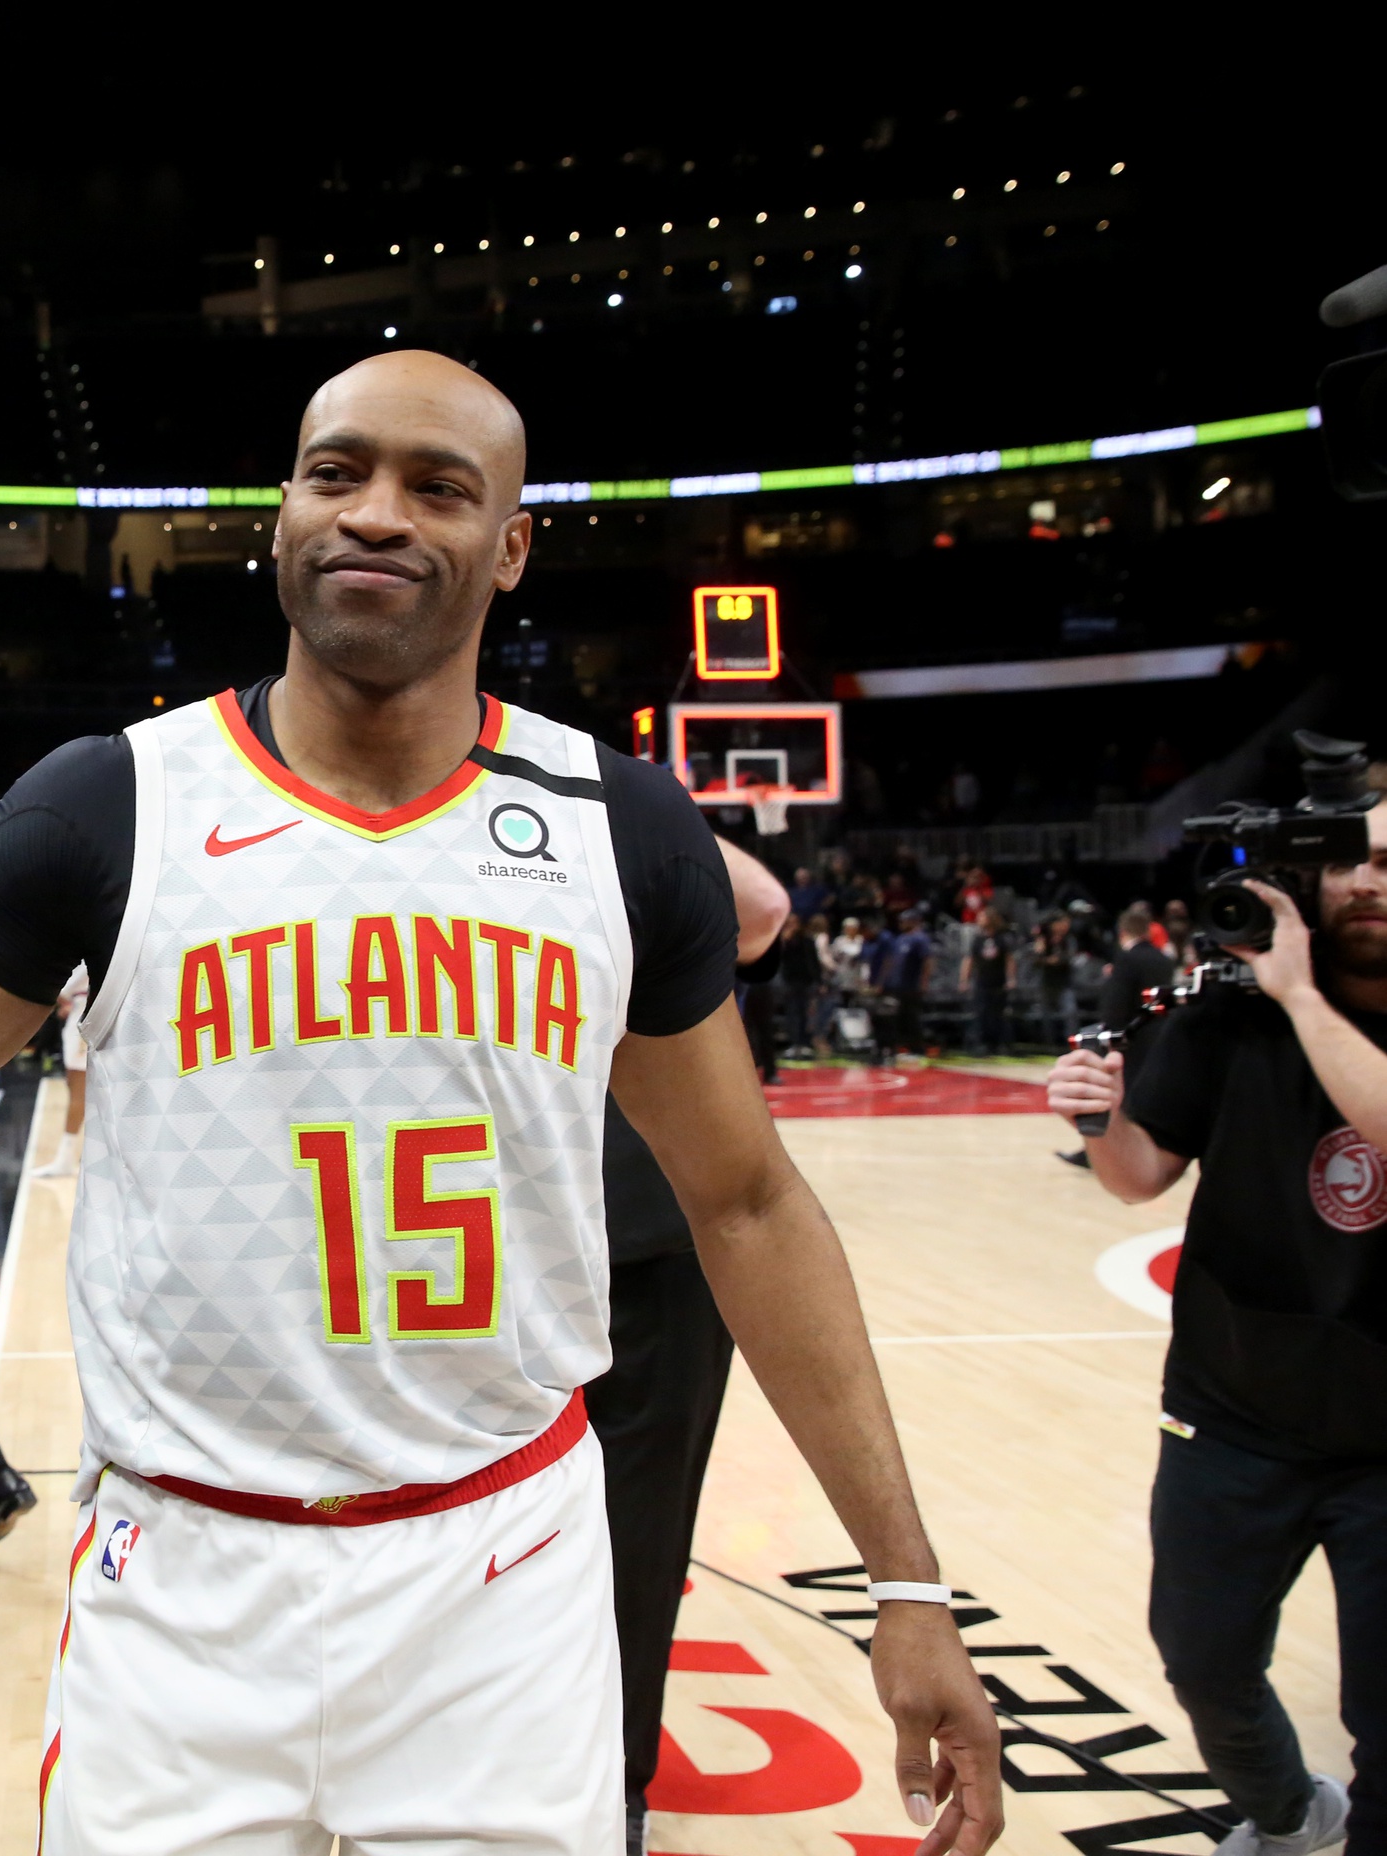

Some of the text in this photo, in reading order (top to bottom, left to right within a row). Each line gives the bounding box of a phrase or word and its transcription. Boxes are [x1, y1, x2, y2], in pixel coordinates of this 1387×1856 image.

[478, 861, 567, 883] sharecare
[169, 913, 588, 1076] ATLANTA
[290, 1114, 503, 1344] 15
